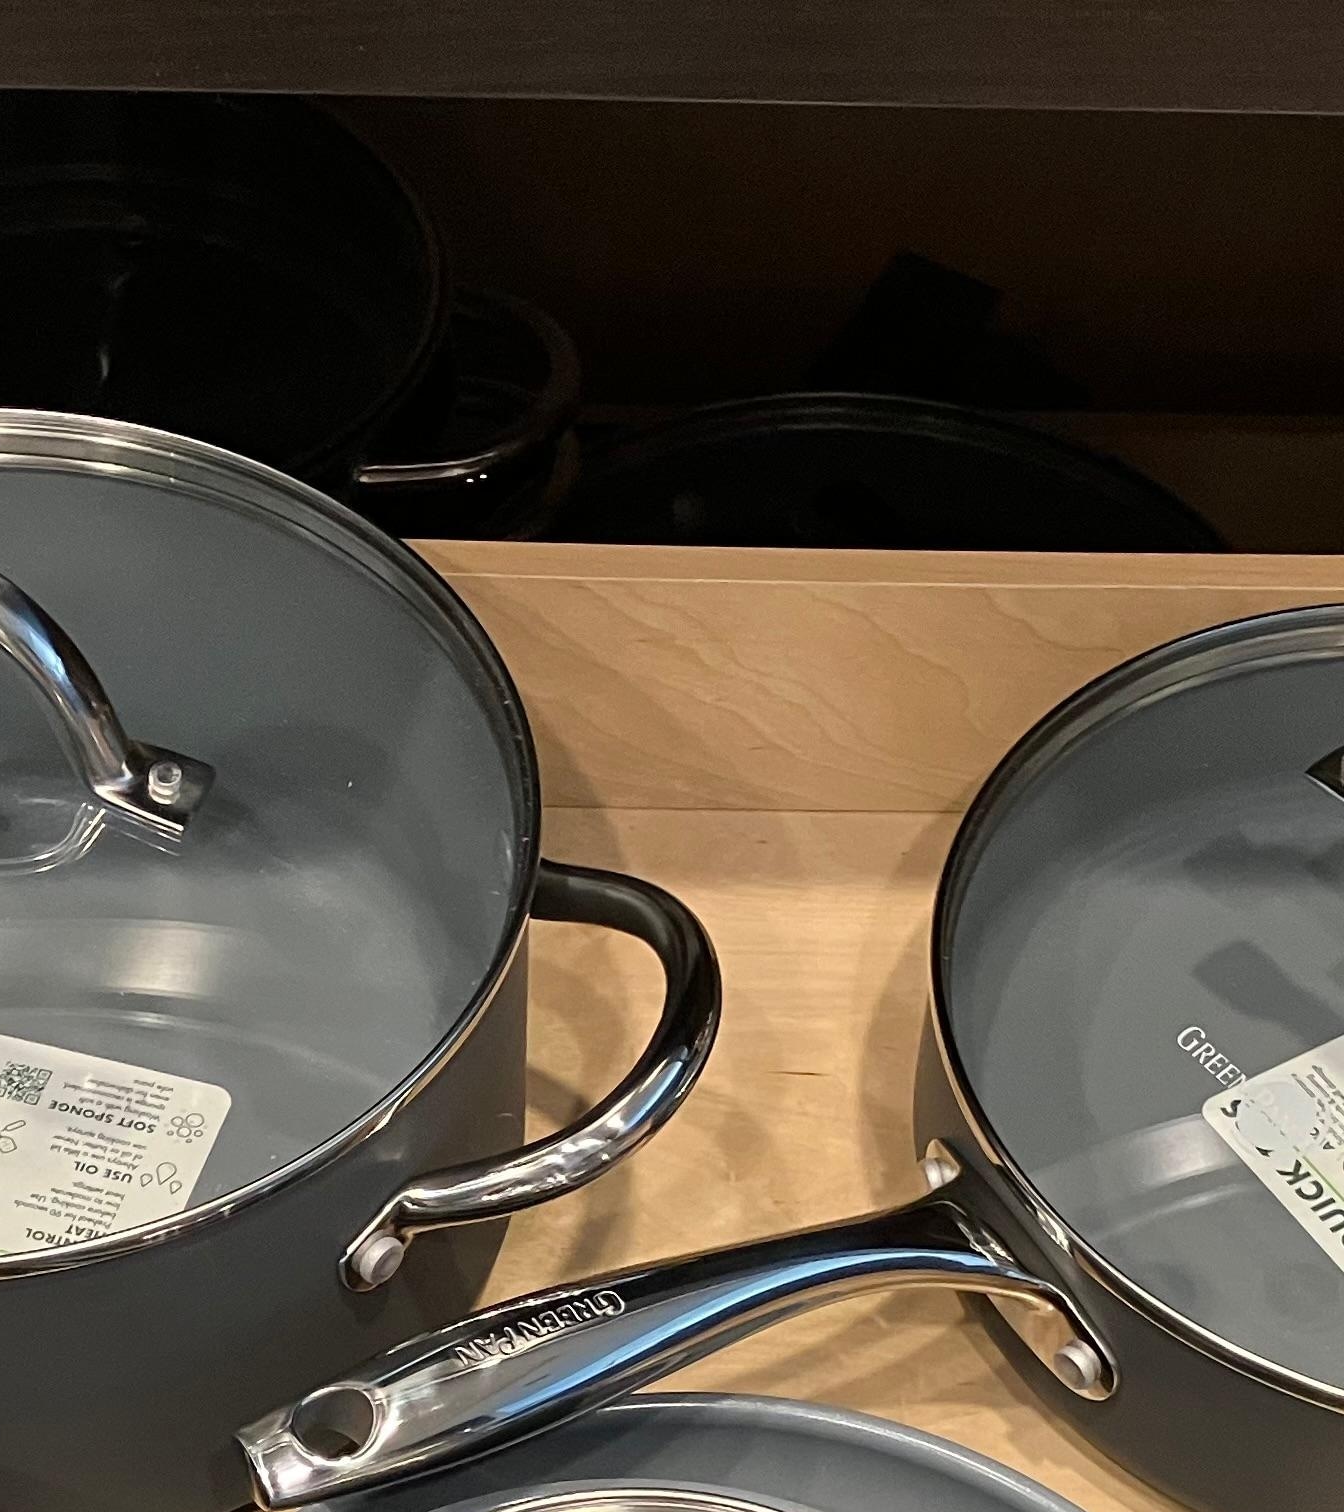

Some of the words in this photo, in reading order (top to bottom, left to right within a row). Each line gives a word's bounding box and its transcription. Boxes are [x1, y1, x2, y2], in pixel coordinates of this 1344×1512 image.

[48, 1099, 114, 1123] SPONGE
[116, 1117, 156, 1133] SOFT
[74, 1160, 98, 1174] OIL
[102, 1168, 132, 1183] USE
